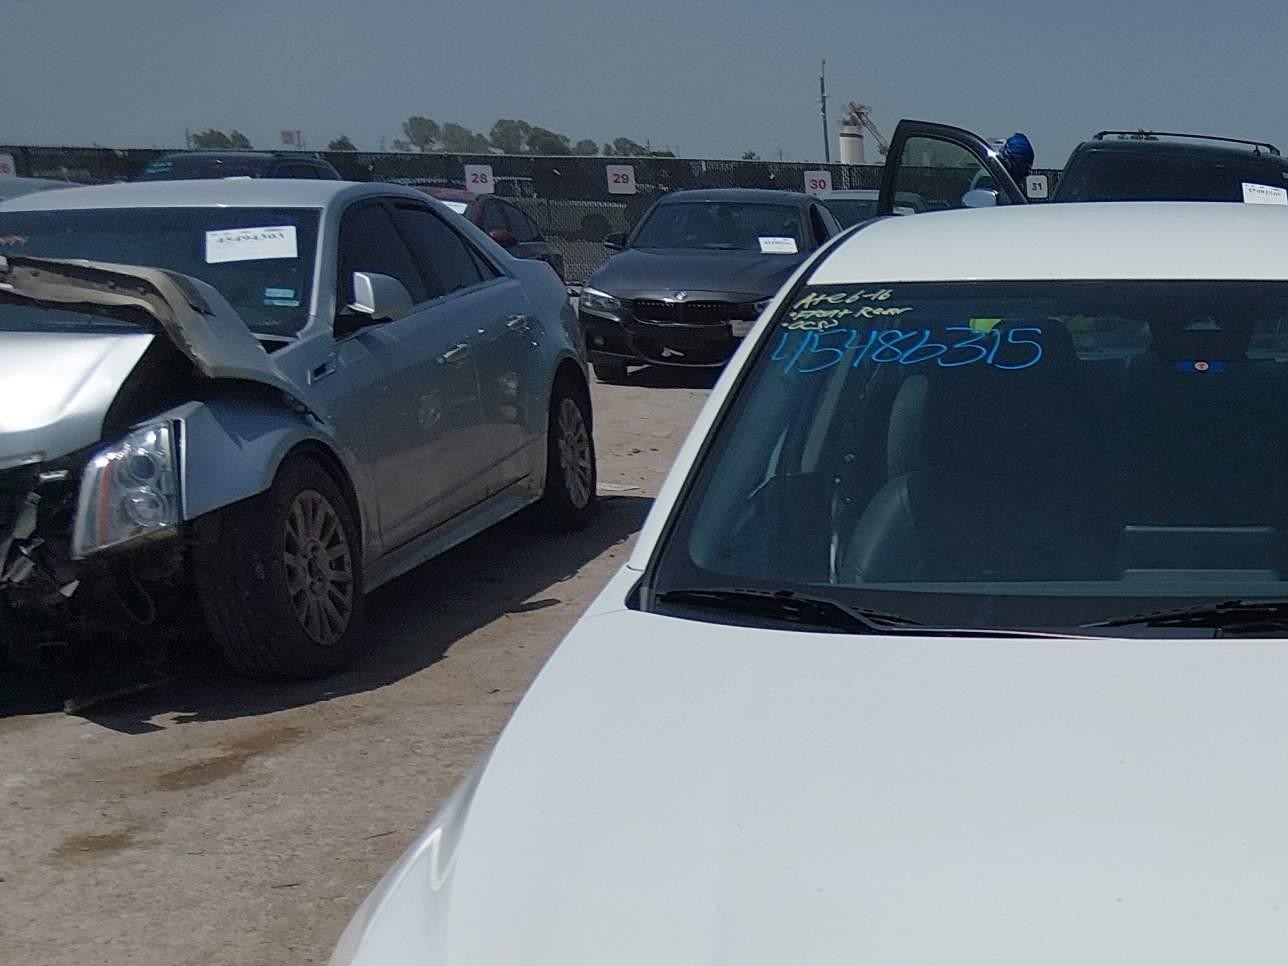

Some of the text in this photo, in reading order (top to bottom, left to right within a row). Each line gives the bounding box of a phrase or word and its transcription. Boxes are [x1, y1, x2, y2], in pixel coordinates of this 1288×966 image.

[471, 173, 488, 183] 28
[613, 173, 629, 184] 29
[810, 179, 827, 190] 30
[1032, 182, 1043, 191] 31
[771, 327, 1042, 373] 45486315
